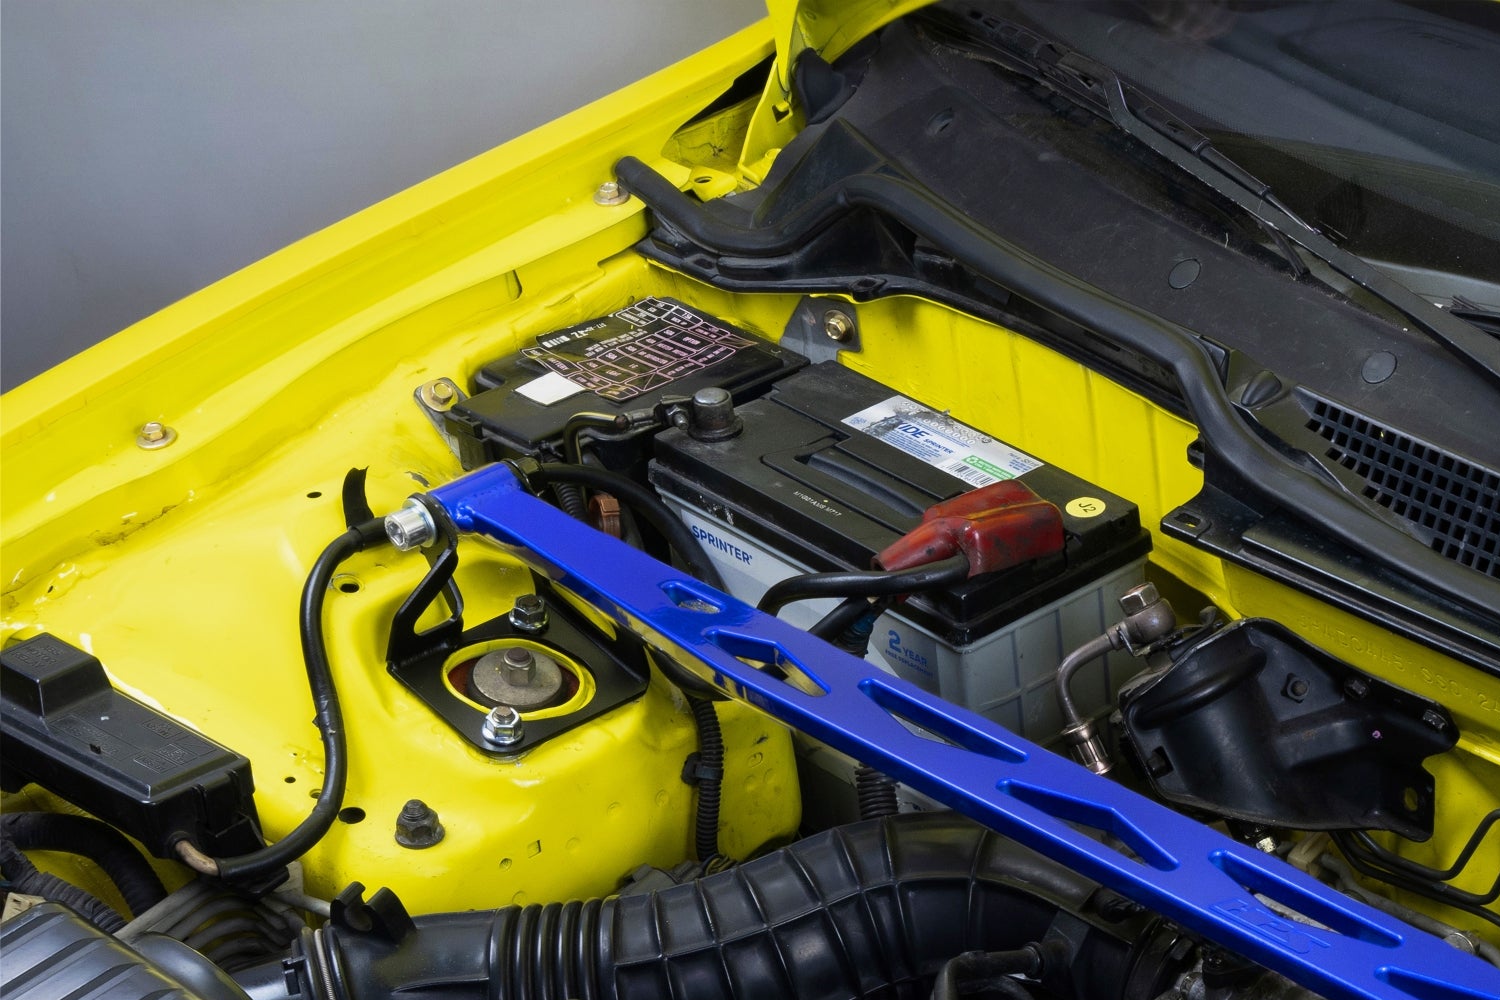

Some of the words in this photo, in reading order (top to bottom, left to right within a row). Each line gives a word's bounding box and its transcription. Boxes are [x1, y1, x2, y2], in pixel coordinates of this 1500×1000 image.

[924, 438, 953, 454] SPRINTER
[1078, 503, 1097, 513] J2
[888, 629, 902, 654] 2
[903, 647, 928, 667] YEAR
